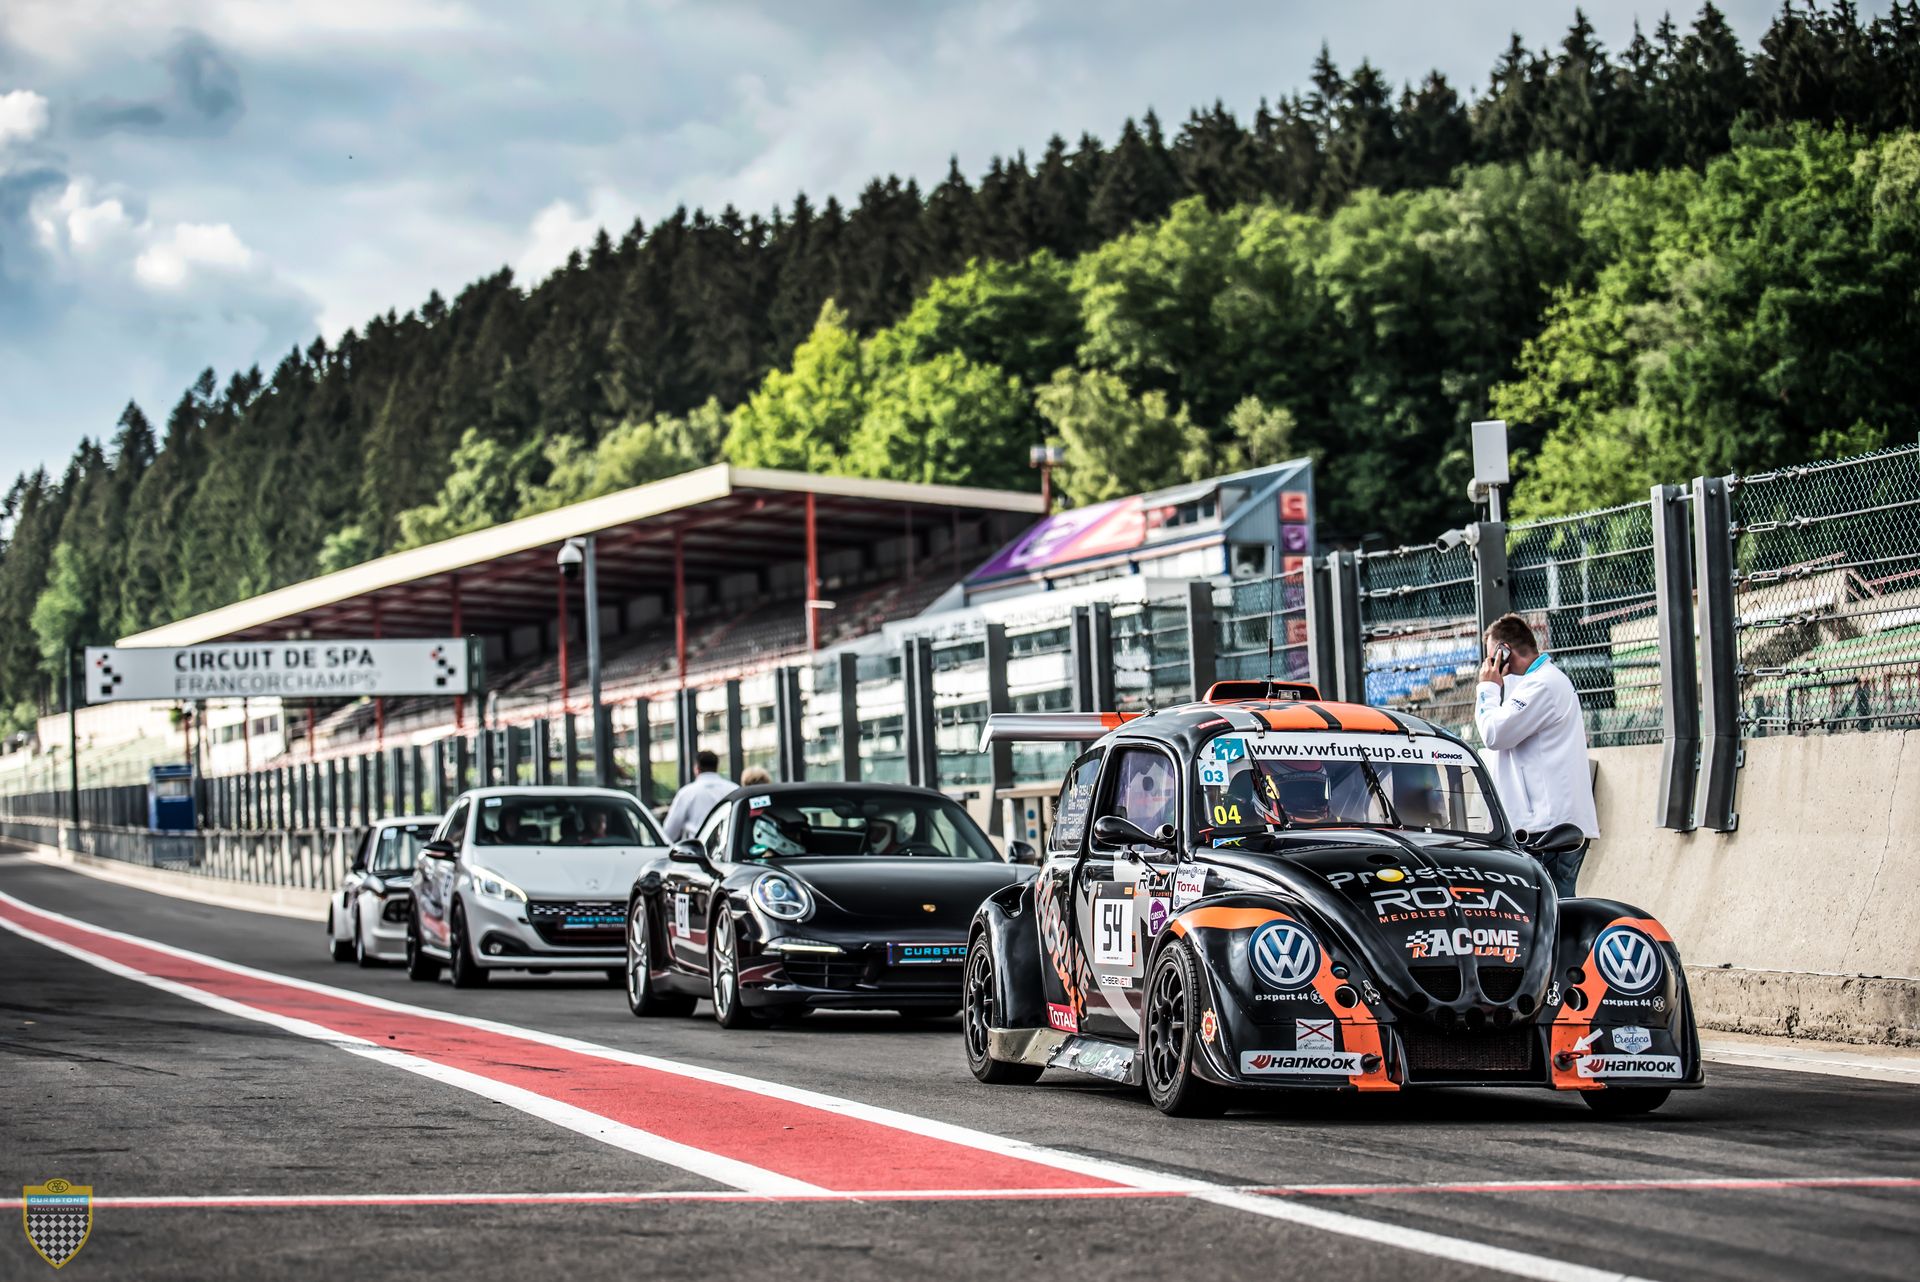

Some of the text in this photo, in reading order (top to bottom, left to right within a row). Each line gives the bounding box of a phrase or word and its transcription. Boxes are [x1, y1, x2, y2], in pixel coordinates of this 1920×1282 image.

[174, 646, 375, 672] CIRCUIT DE SPA
[174, 670, 377, 694] FRANCORCHAMPS
[1251, 741, 1424, 761] www.vwfuncup.eu
[1203, 769, 1224, 782] 03
[1213, 804, 1242, 825] 04
[1370, 886, 1525, 916] ROSA
[1379, 909, 1530, 924] MEUBLES CUISINES
[1102, 903, 1123, 952] 54
[1255, 993, 1309, 1002] expert 44
[1602, 999, 1652, 1007] expert 44
[1048, 1005, 1077, 1029] TOTAL
